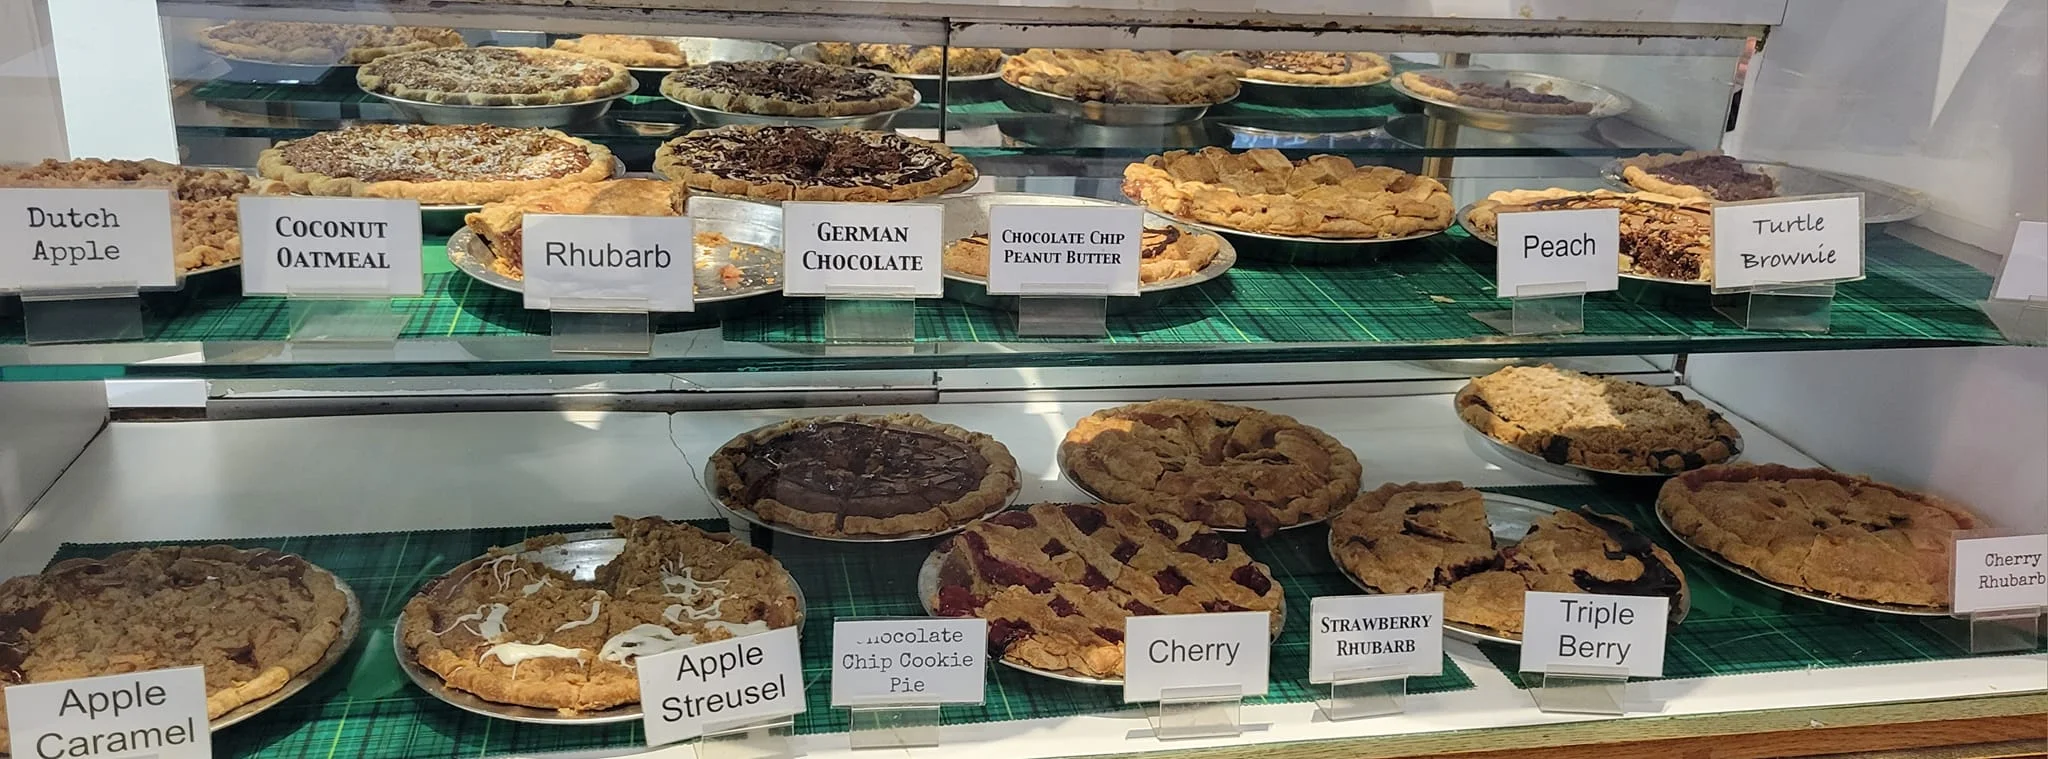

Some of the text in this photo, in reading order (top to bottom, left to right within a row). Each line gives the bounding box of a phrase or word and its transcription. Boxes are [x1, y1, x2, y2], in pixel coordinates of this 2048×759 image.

[26, 206, 121, 229] Dutch
[275, 215, 388, 239] COCONUT
[1752, 213, 1825, 235] Turtle
[817, 221, 909, 243] GERMAN
[1001, 229, 1125, 245] CHOCOLATE CHIP
[31, 239, 121, 266] Apple
[546, 241, 672, 269] Rhubarb
[1004, 249, 1121, 265] PEANUT BUTTER
[1524, 232, 1596, 259] Peach
[1740, 243, 1837, 269] Brownie
[276, 246, 391, 269] OATMEAL
[802, 250, 923, 271] CHOCOLATE
[1985, 552, 2043, 568] Cherry
[1978, 571, 2047, 590] Rhubarb
[1320, 614, 1433, 634] STRAWBERRY
[1560, 600, 1635, 629] Triple
[856, 627, 964, 645] ocolate
[1148, 639, 1241, 667] Cherry
[1336, 639, 1416, 657] RHUBARB
[1558, 634, 1632, 666] Berry
[676, 643, 764, 682] Apple
[842, 651, 974, 673] Chip Cookie
[889, 677, 925, 693] Pie
[59, 681, 167, 720] Apple
[661, 673, 786, 723] Streusel
[36, 716, 195, 759] Caramel
